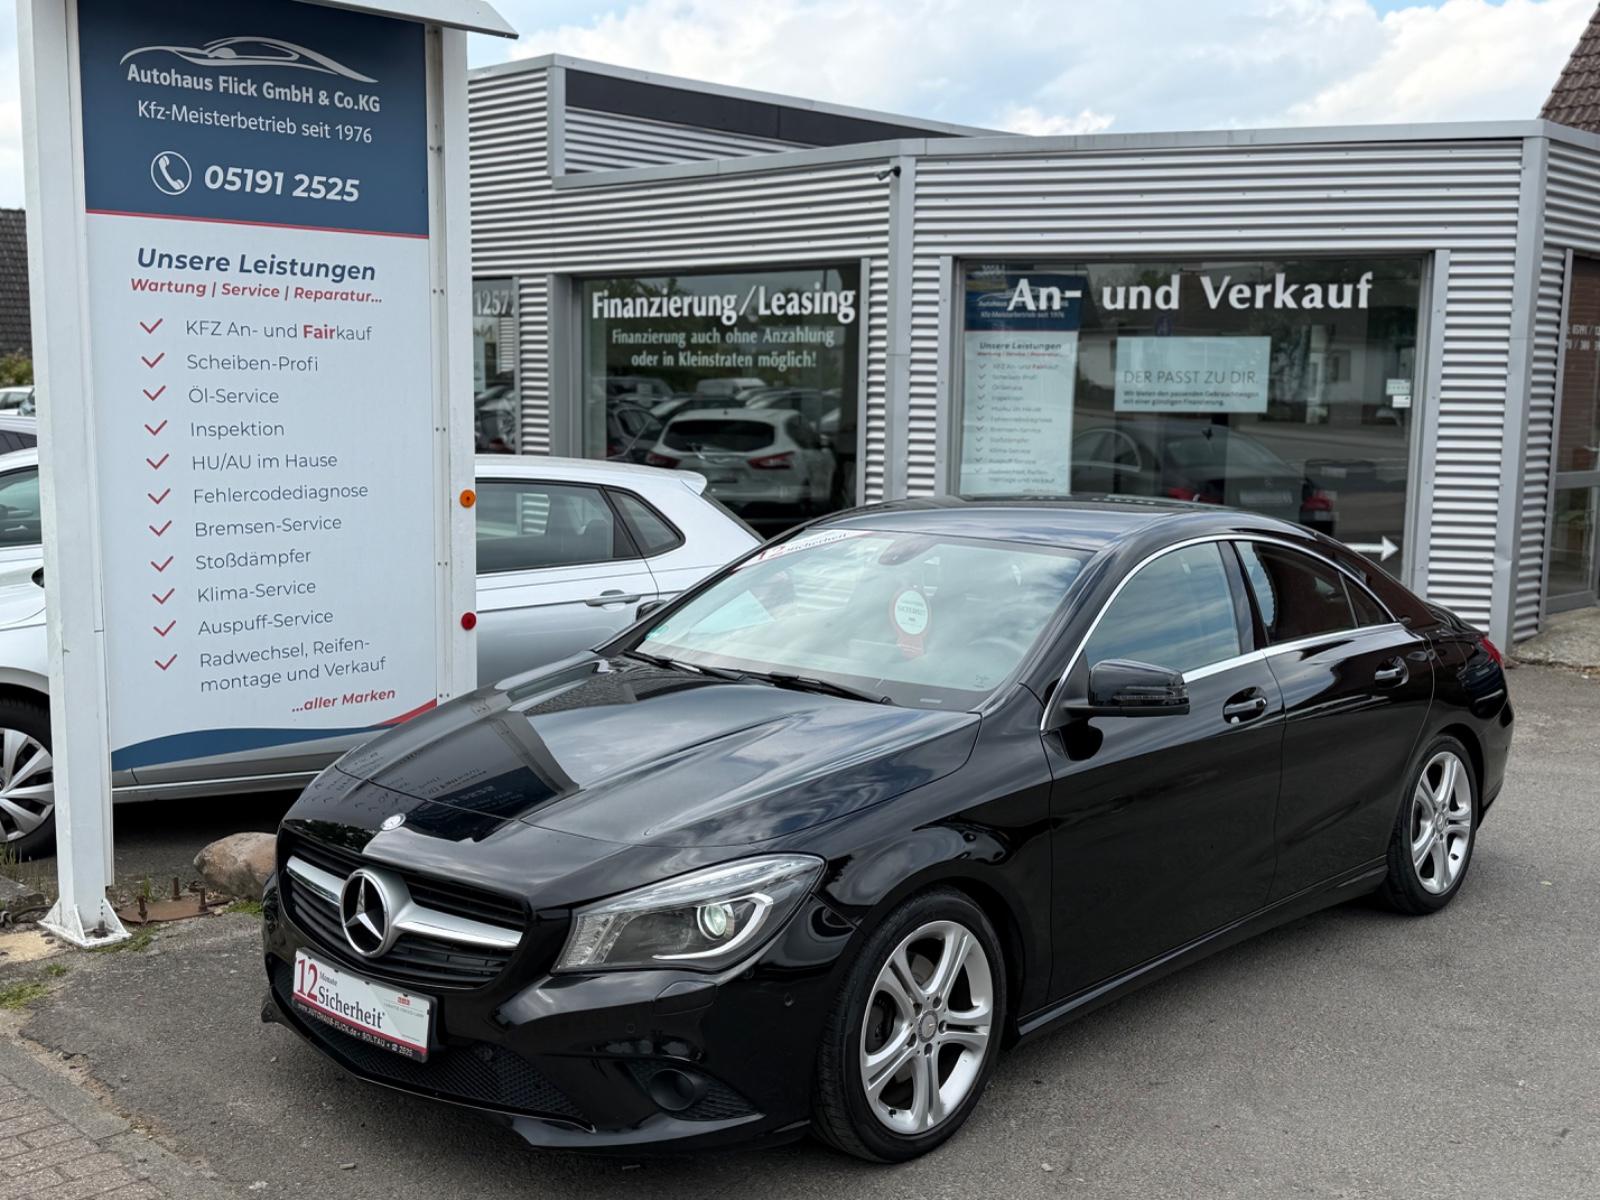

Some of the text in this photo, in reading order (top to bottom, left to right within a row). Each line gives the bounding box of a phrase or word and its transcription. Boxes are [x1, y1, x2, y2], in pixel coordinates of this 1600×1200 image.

[127, 63, 381, 113] Autohaus Flick GmbH & Co.KG
[137, 100, 373, 143] Kfz-Meisterbetrieb seit 1976
[204, 165, 360, 203] 05191 2525
[136, 247, 376, 283] Unsere Leistungen
[130, 278, 207, 298] Wartung
[221, 283, 281, 299] Service
[293, 287, 382, 304] Reparatur...
[1007, 271, 1373, 312] An- und Verkauf
[185, 320, 373, 342] KFZ An- und Fairkauf
[611, 325, 834, 348] Finanzierung auch ohne Anzahlung
[186, 353, 319, 372] Scheiben-Profi
[631, 350, 817, 372] oder in Kleinstraten möglich!
[1123, 370, 1258, 384] DER PASST ZU DIR.
[188, 385, 280, 405] Öl-Service
[189, 419, 285, 440] Inspektion
[191, 451, 338, 472] HU/AU im Hause
[193, 482, 369, 505] Fehlercodediagnose
[194, 514, 343, 538] Bremsen-Service
[194, 548, 312, 572] Stoßdämpfer
[197, 579, 316, 603] Klima-Service
[198, 608, 334, 637] Auspuff-Service
[199, 637, 371, 670] Radwechsel, Reifen-
[200, 656, 386, 693] montage und Verkauf
[291, 687, 396, 714] ...aller Marken
[297, 959, 319, 1002] 12
